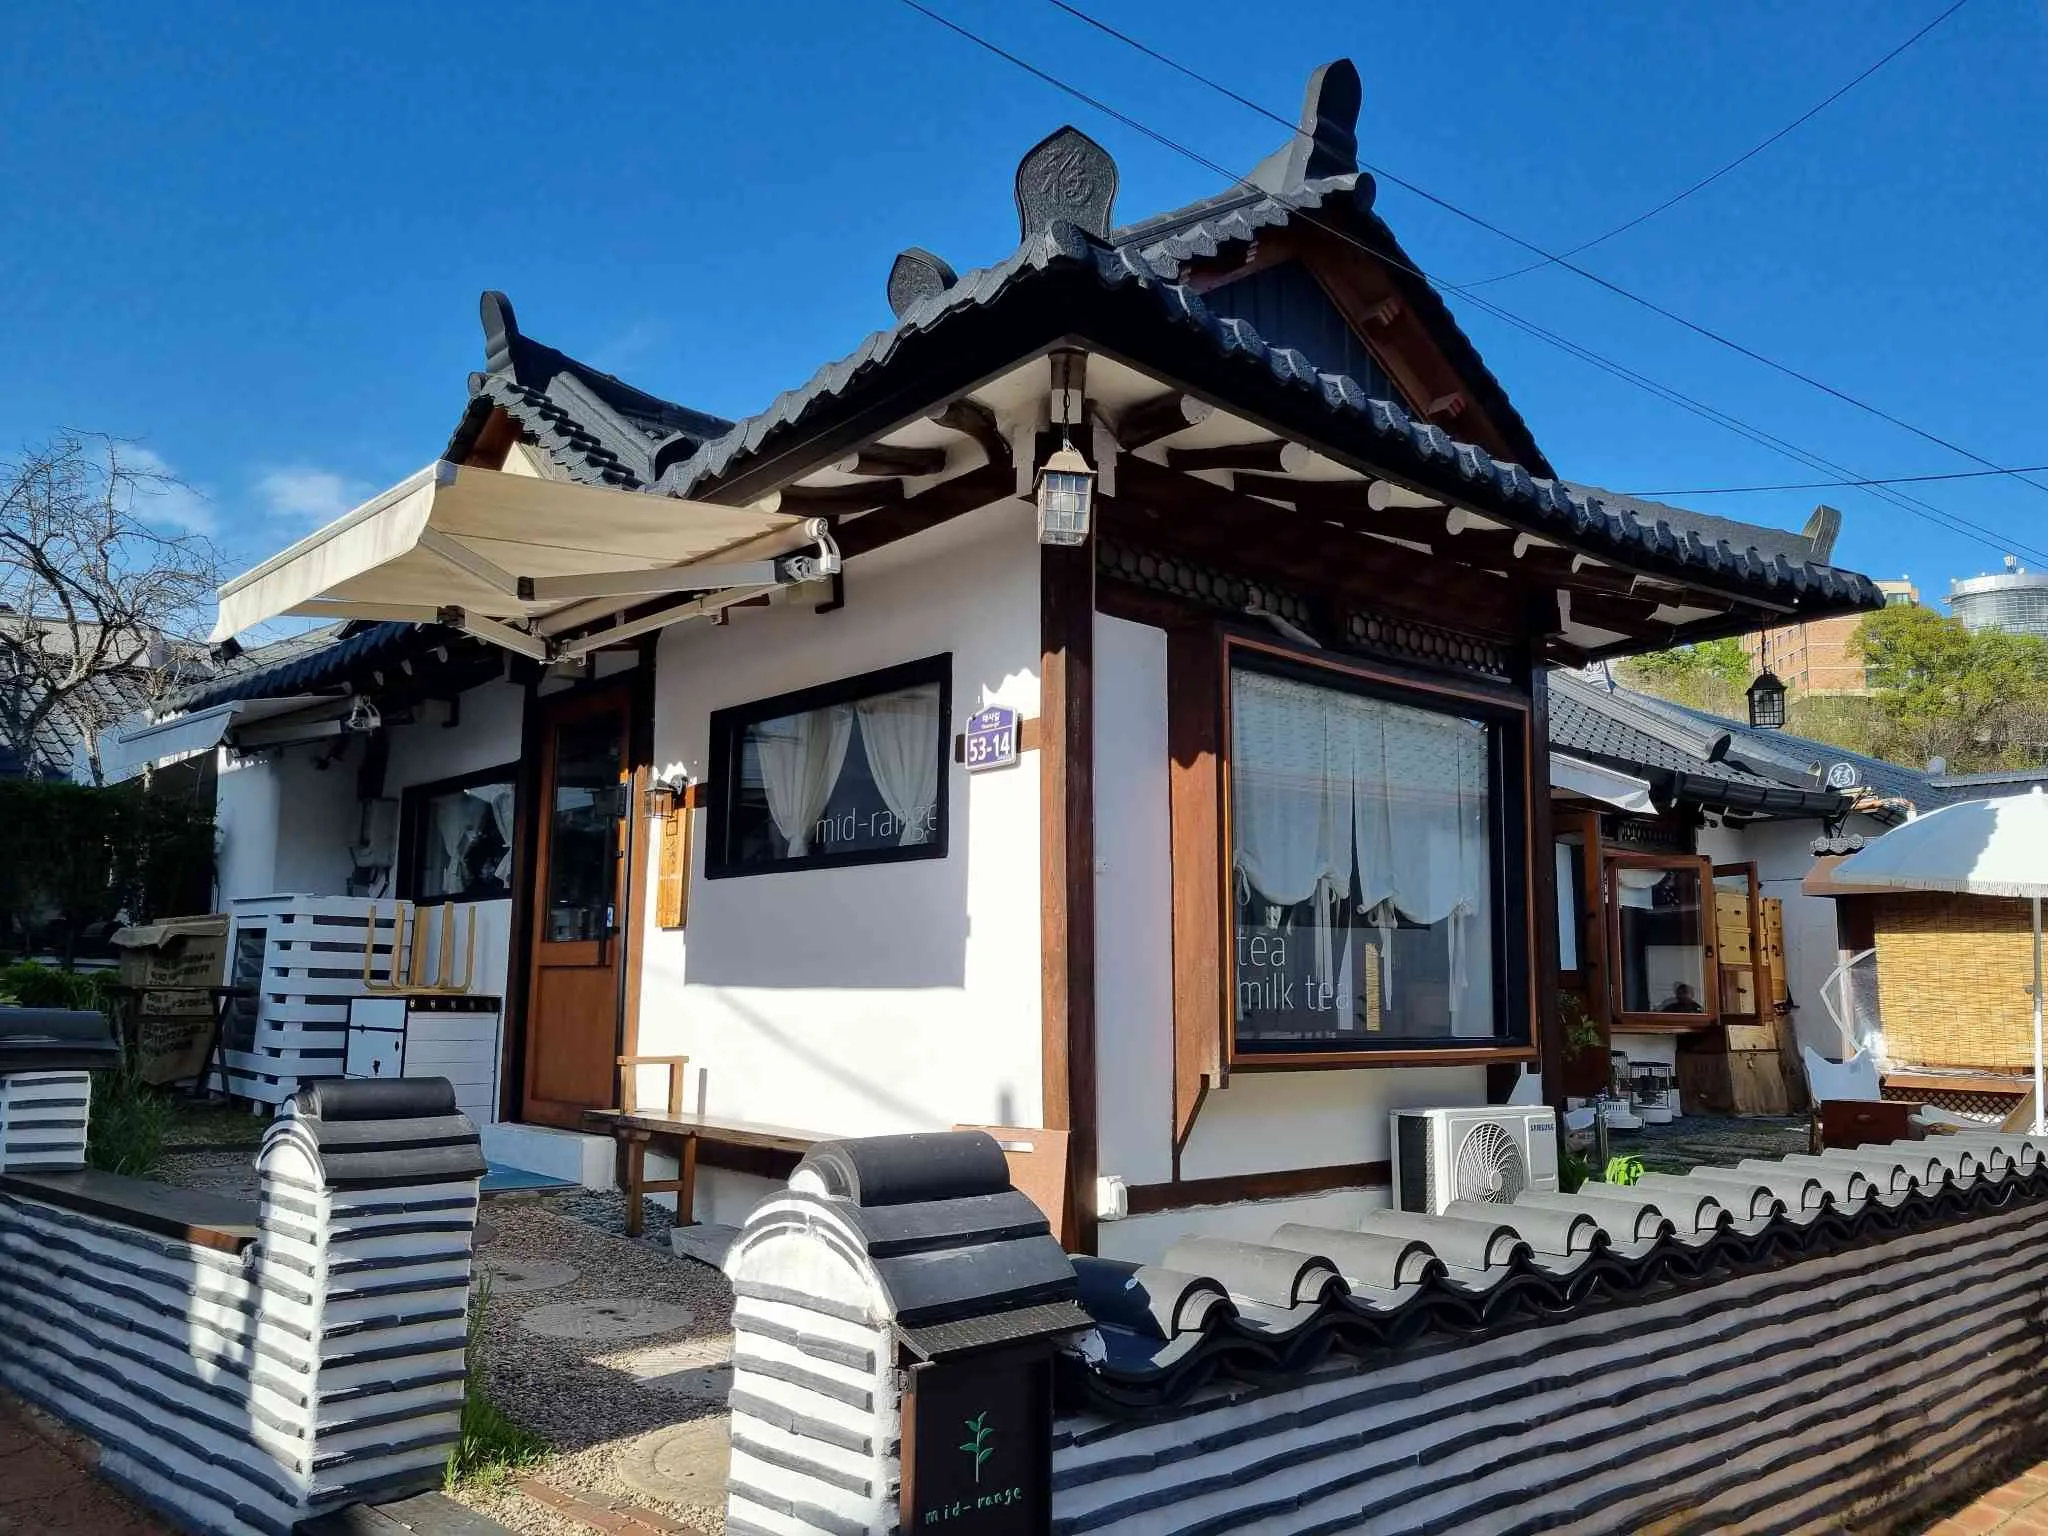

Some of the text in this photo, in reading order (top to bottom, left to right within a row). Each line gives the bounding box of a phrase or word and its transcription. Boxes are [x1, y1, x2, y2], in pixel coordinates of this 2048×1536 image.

[968, 732, 1011, 762] 53-14
[1236, 927, 1286, 967] tea
[1238, 972, 1350, 1011] milk tea
[925, 1487, 1022, 1525] mid-range
